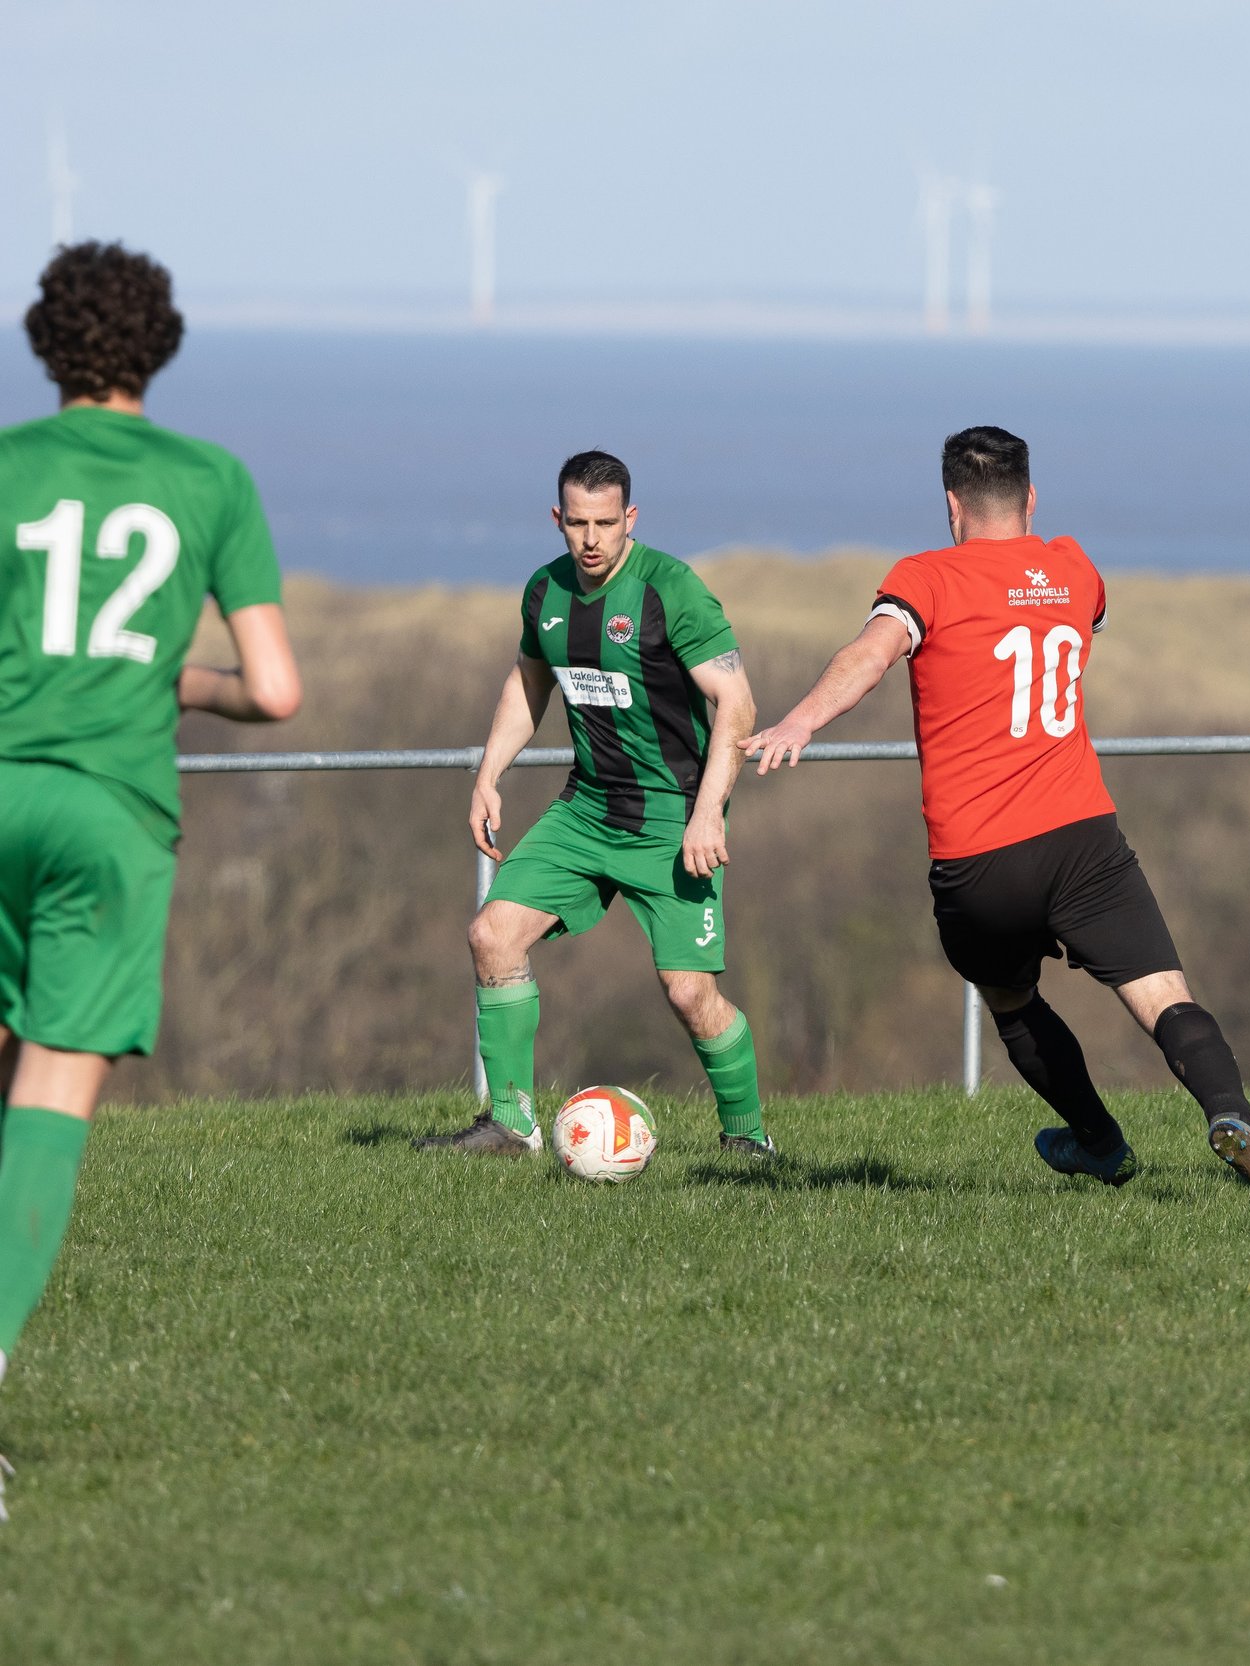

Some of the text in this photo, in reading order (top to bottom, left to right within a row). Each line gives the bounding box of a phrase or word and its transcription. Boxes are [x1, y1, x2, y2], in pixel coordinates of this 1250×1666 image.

[16, 499, 181, 664] 12
[1008, 586, 1069, 598] RG HOWELLS
[1008, 597, 1041, 606] cleaning
[569, 670, 613, 685] Lakeland
[993, 624, 1083, 738] 10
[703, 907, 714, 932] 5
